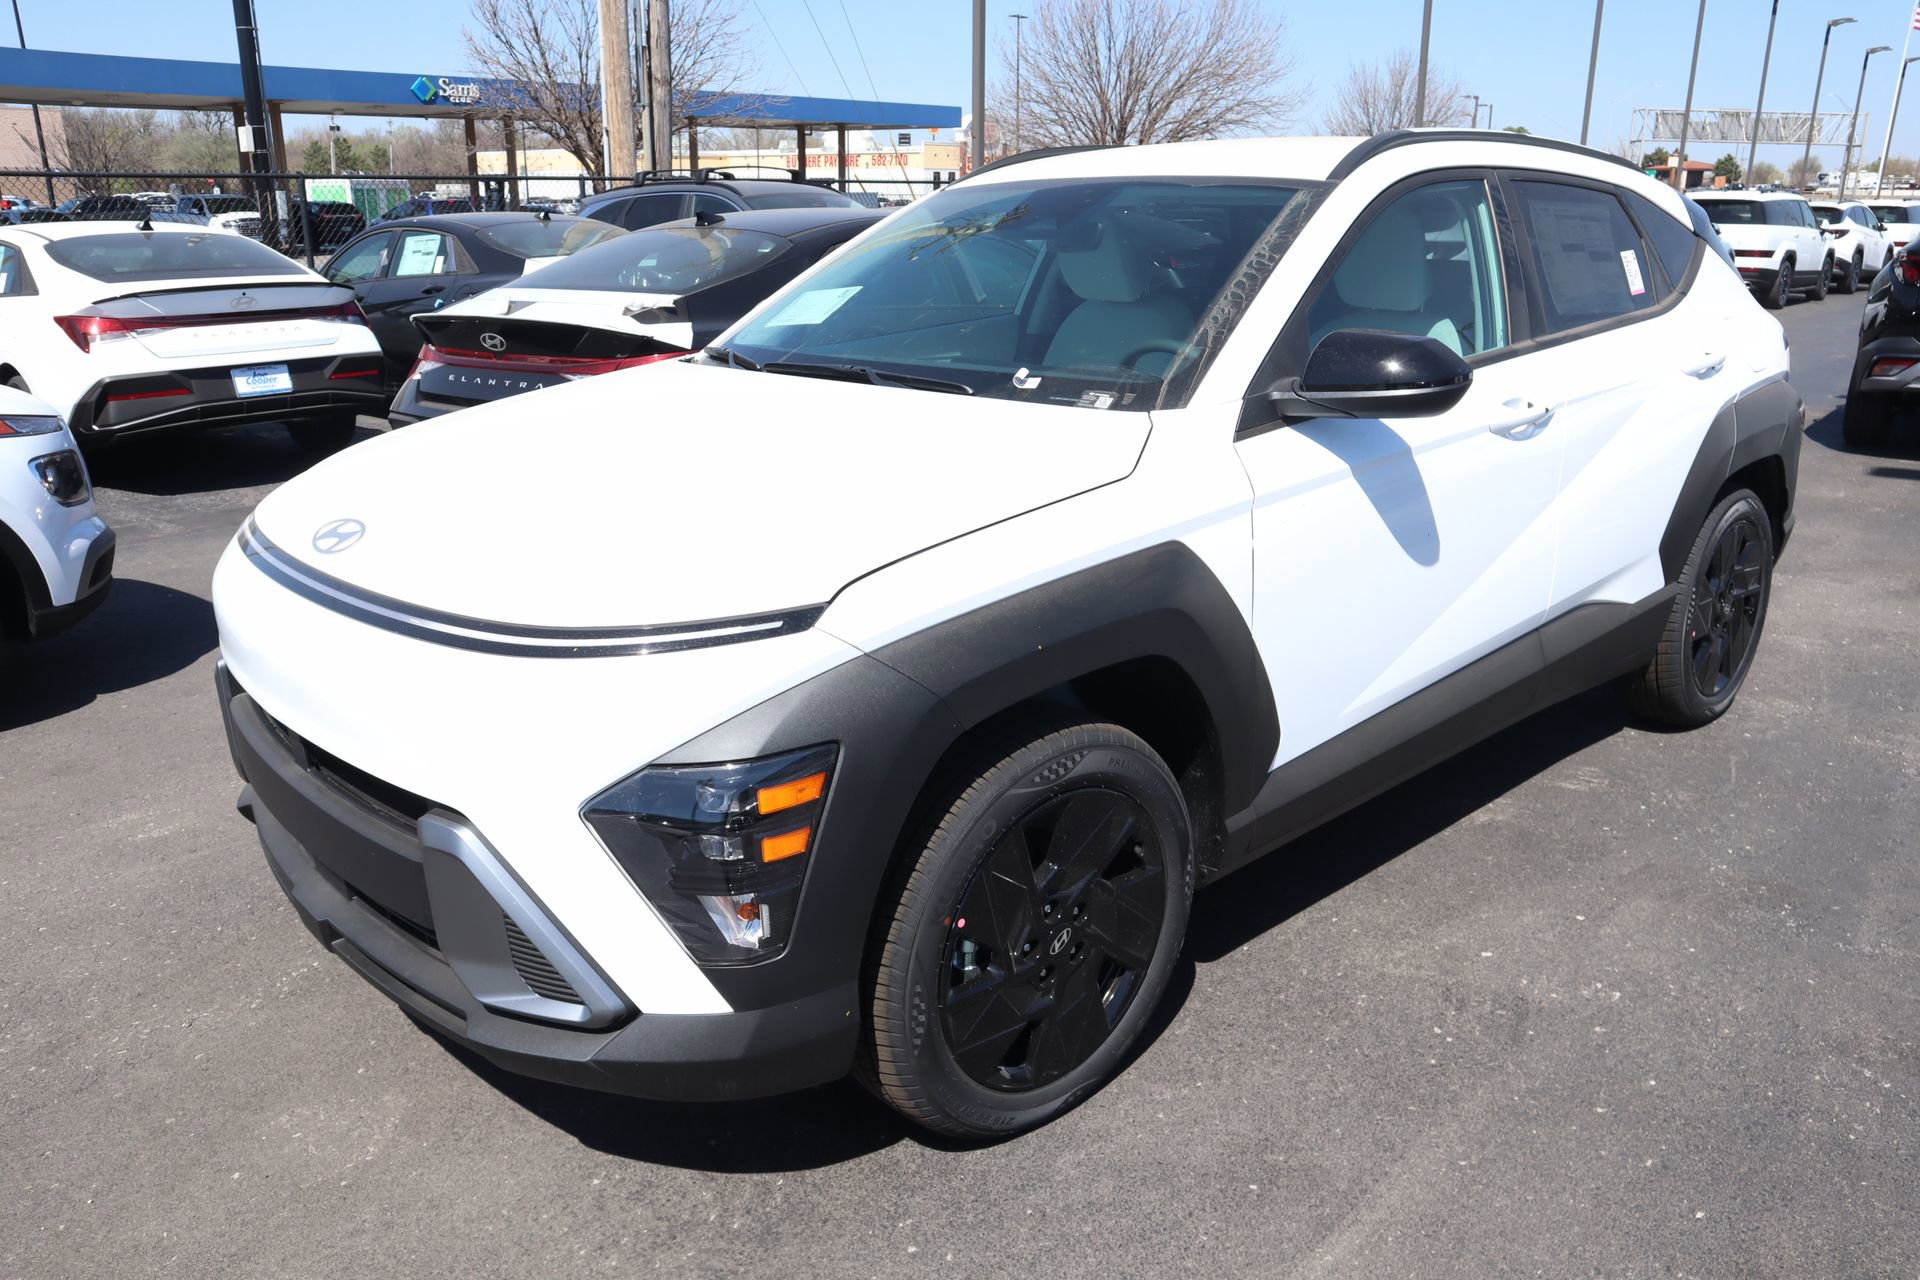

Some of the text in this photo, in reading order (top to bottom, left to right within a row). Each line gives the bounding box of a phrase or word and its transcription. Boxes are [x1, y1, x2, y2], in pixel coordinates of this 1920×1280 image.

[438, 78, 480, 97] Sam's
[786, 155, 799, 168] BU
[824, 154, 838, 168] PAY
[246, 377, 279, 385] Cooper
[448, 374, 544, 389] ELANTRA
